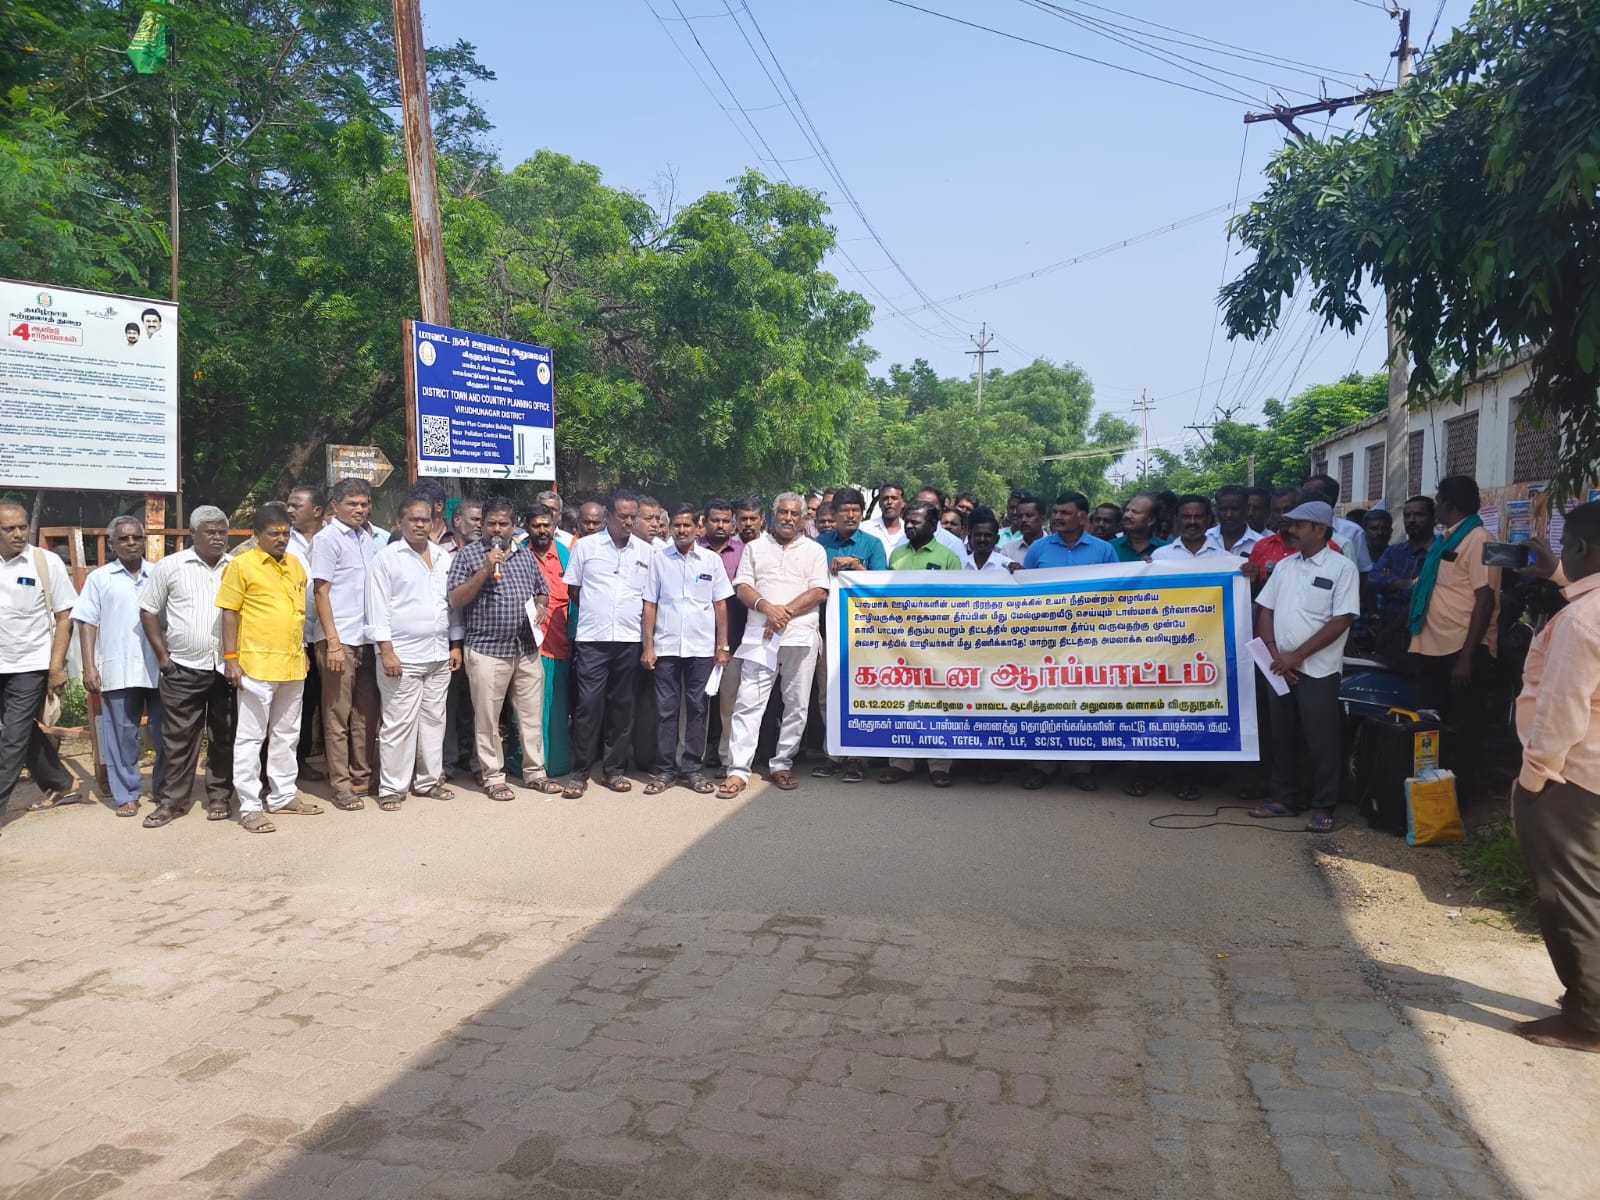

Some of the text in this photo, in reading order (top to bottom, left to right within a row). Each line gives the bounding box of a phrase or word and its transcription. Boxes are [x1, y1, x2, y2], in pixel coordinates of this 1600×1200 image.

[13, 323, 31, 341] 4
[418, 331, 550, 363] மாவட்ட நகர் ஊரமைப்பு அலுவலகம்
[461, 350, 516, 366] விருதுநகர் மாவட்டம்
[422, 386, 550, 412] DISTRICT TOWN AND COUNTRY PLANNING OFFICE
[454, 405, 526, 420] VIRUDHUNAGAR DISTRICT
[477, 421, 495, 430] Complex
[464, 430, 483, 438] Pollution
[452, 438, 481, 448] Virudhunagar
[452, 448, 481, 458] Virudhunagar
[479, 467, 491, 475] WAY
[854, 593, 1159, 610] டாஸ்மாக் ஊழியர்களின் பணி நிரந்தர வழக்கில் உயர் நீதிமன்றம் வழங்கிய
[854, 604, 1216, 623] ஊழியருக்கு சாதகமான தீர்ப்பின் மீது மேல்முறையீடு செய்யும் டாஸ்மாக் நிர்வாகமே!
[854, 619, 1185, 637] காலி பாட்டில் திரும்ப பெறும் திட்டத்தில் முழுமையான தீர்ப்பு வருவதற்கு முன்பே
[854, 633, 1203, 650] அவசர கதியில் ஊழியர்கள் மீது திணிக்காதே! மாற்று திட்டத்தை அமலாக்க வலியுறுத்தி...
[854, 651, 1217, 692] கண்டன ஆர்ப்பாட்டம்
[853, 699, 1223, 713] 08.12.2025 திங்கட்கிழமை மாவட்ட ஆட்சித்தலைவர் அலுவலக வளாகம் விருதுநகர்.
[848, 718, 1231, 735] விருதுநகர் மாவட்ட டாஸ்மாக் அனைத்து தொழிற்சங்கங்களின் கூட்டு நடவடிக்கை குழு.
[891, 735, 1180, 748] CITU, AITUC, TGTEU, ATP, LLF, SC/ST, TUCC, BMS, TNTISETU,
